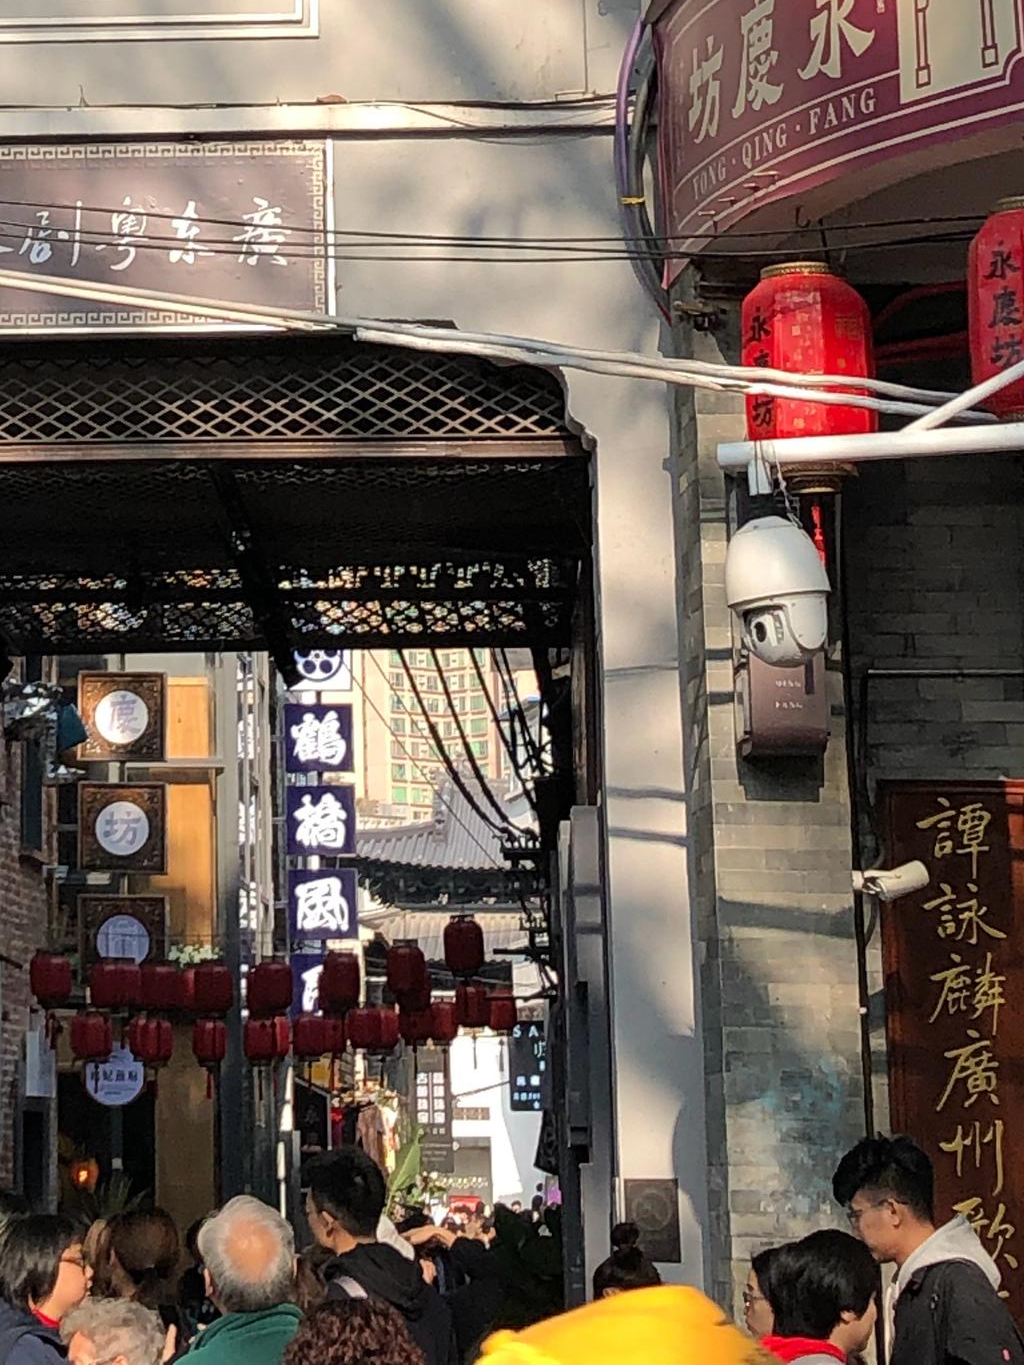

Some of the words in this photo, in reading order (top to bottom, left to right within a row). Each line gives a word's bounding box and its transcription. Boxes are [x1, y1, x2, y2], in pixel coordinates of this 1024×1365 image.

[692, 156, 728, 201] YONG
[742, 123, 787, 170] QING
[808, 87, 877, 136] FANG
